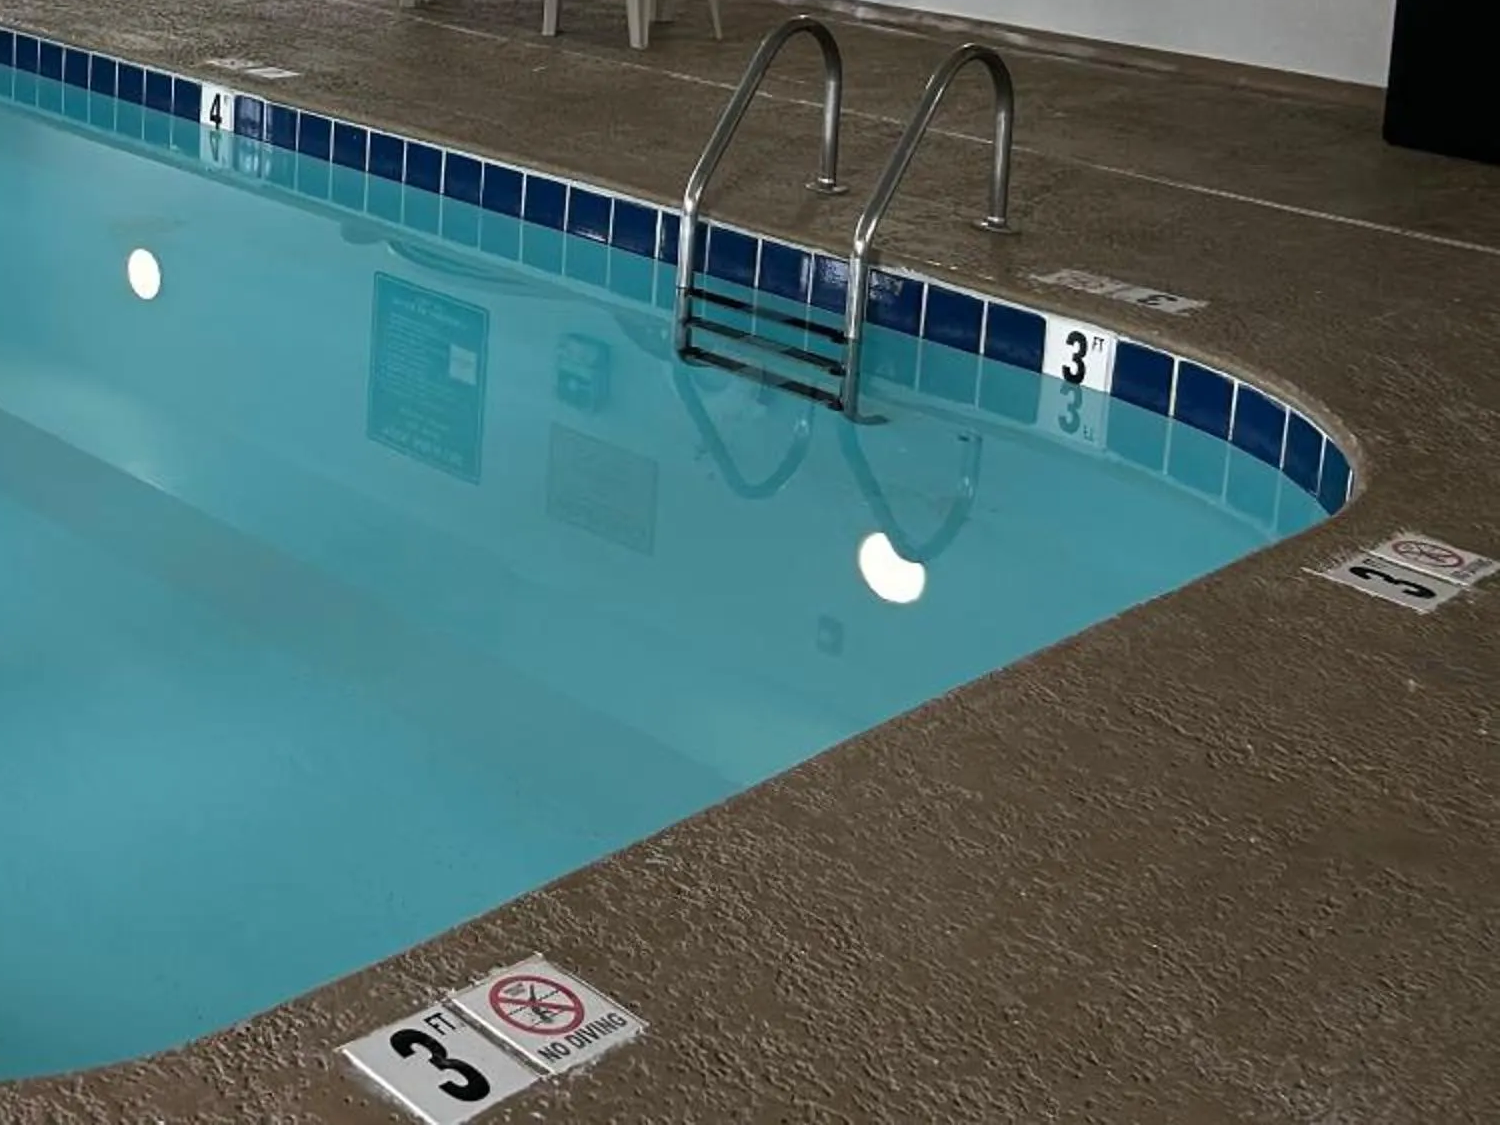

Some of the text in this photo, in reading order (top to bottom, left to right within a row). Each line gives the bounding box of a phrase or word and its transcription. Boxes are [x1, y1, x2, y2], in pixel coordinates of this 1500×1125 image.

[210, 93, 222, 130] 4
[1062, 330, 1104, 384] 3 FT
[1349, 566, 1437, 599] 3
[390, 1012, 490, 1102] 3 FT
[538, 1013, 627, 1062] NO DIVING
